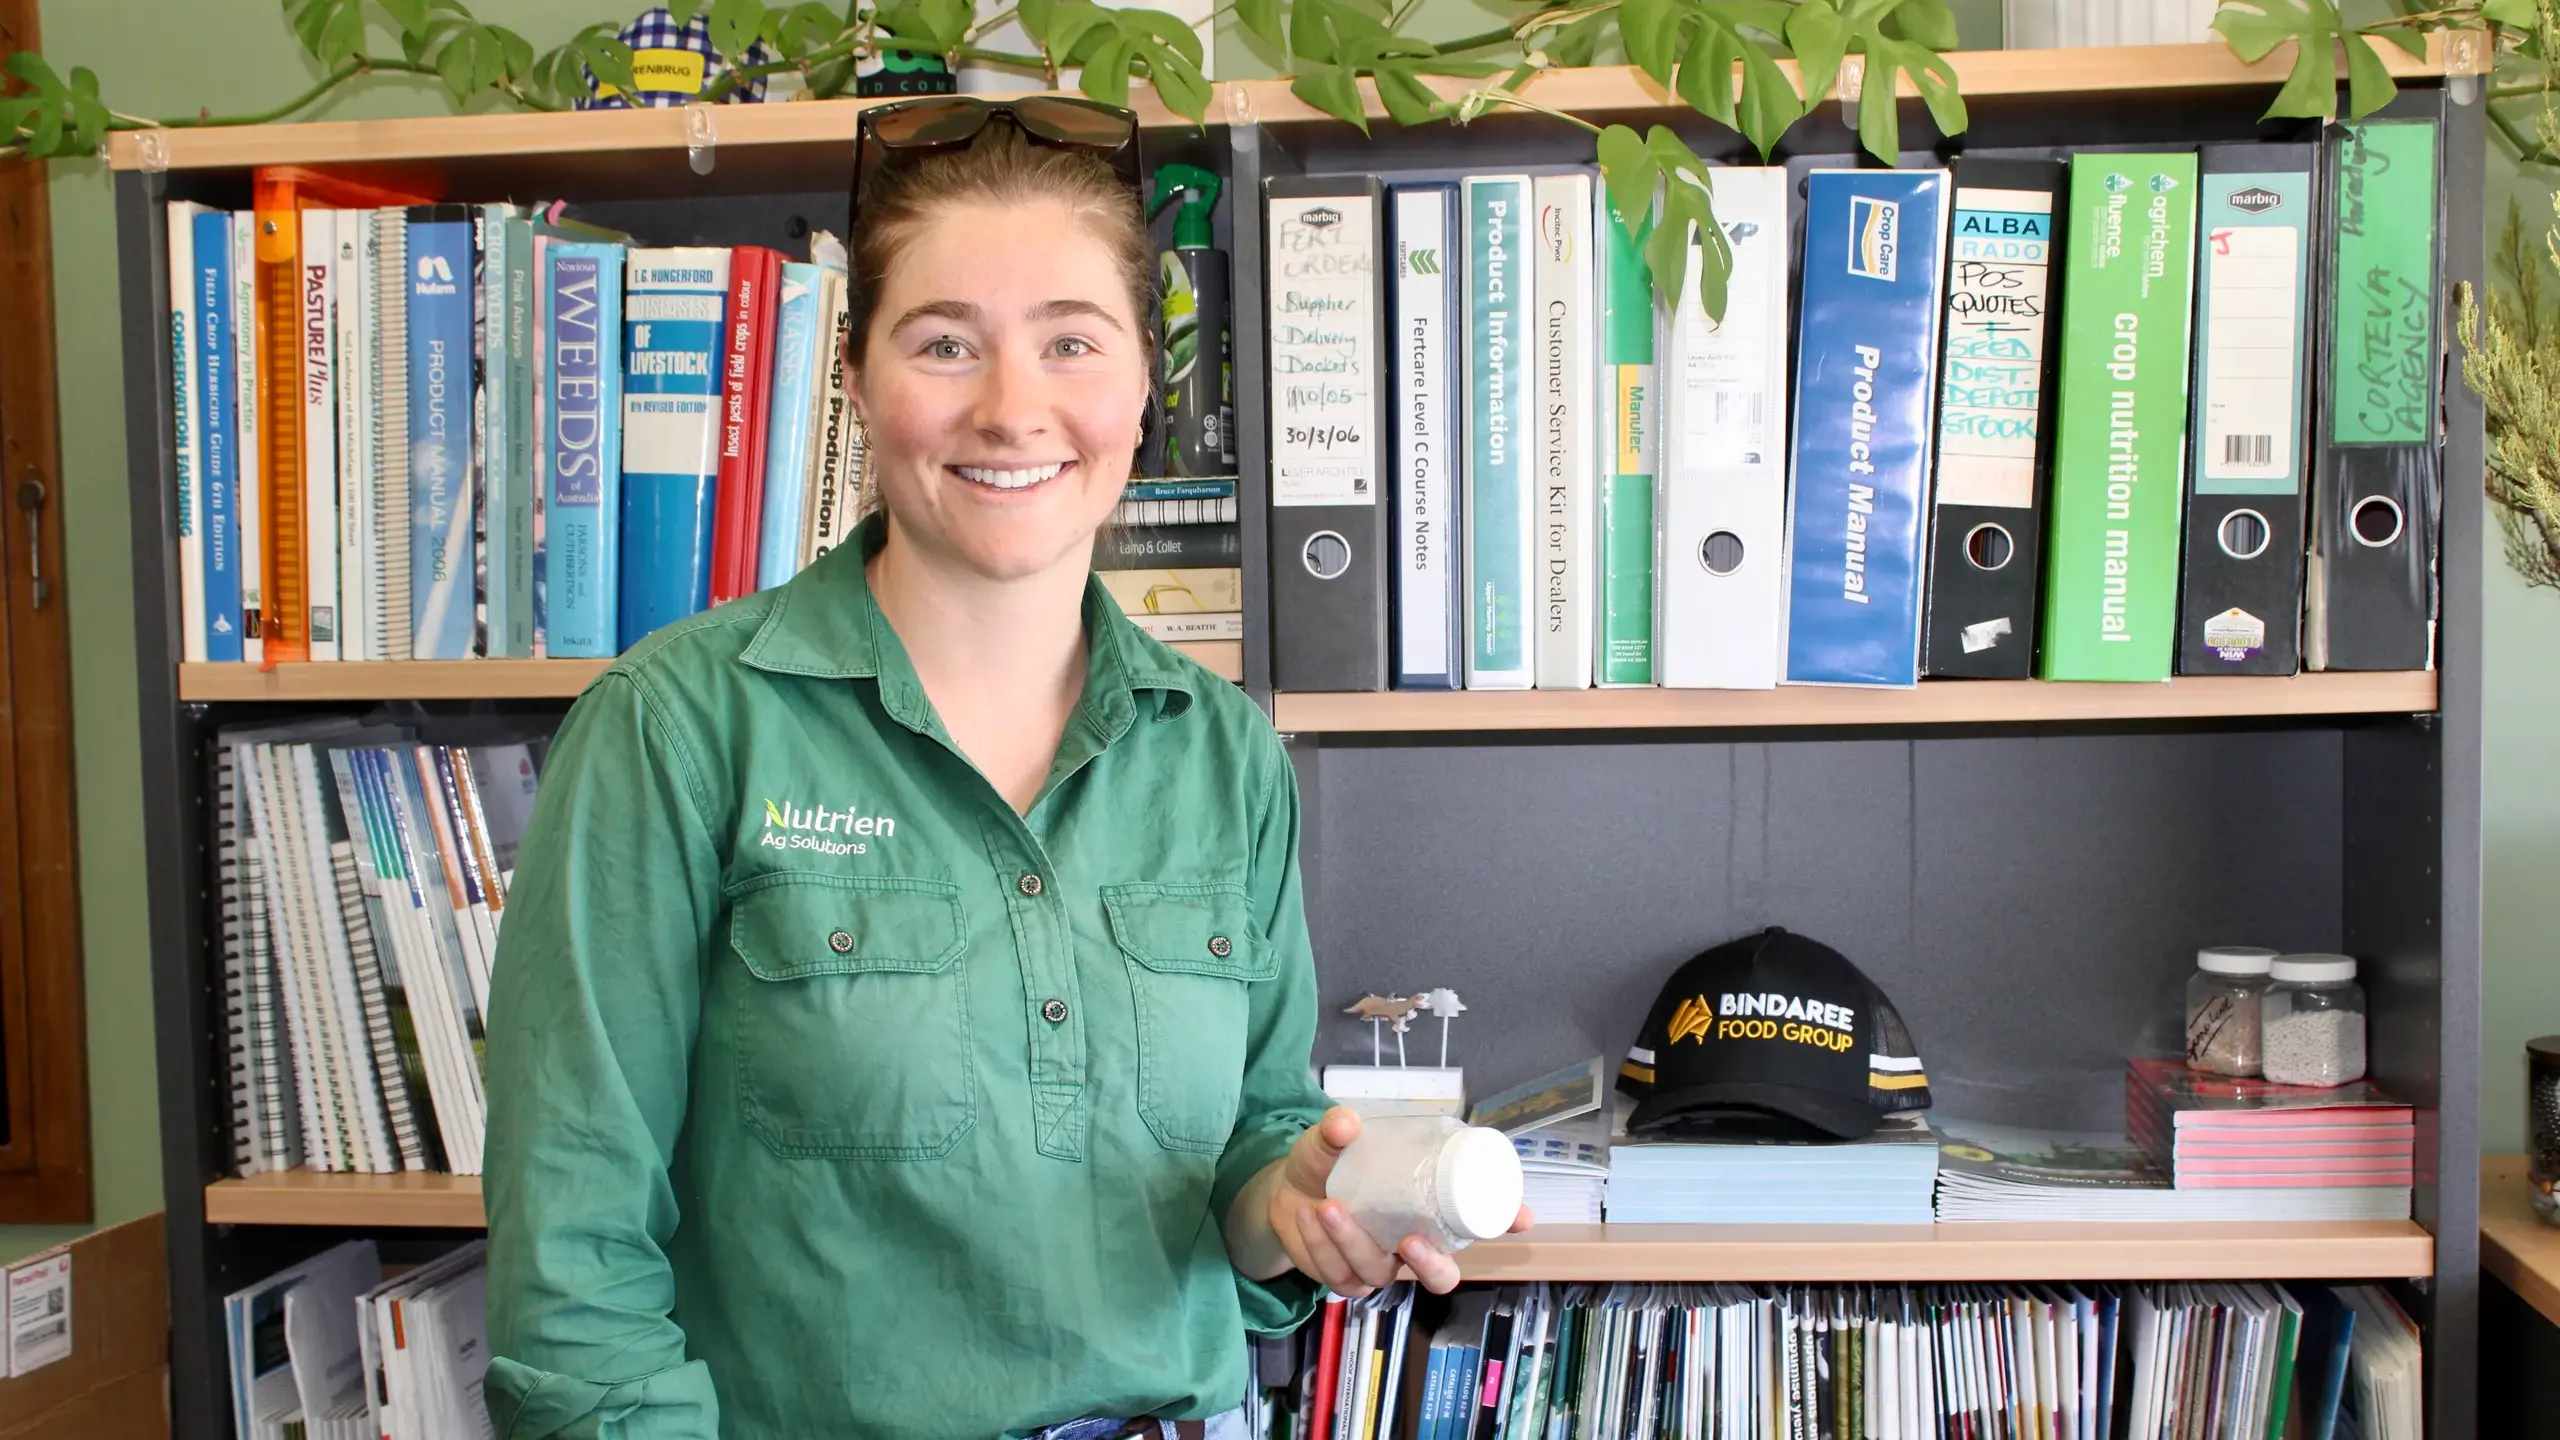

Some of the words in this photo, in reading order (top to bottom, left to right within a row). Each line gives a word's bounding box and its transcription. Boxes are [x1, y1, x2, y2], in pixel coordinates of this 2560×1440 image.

[2231, 191, 2279, 206] marbig
[1302, 211, 1340, 224] marbig
[1553, 207, 1561, 238] Incitec
[1878, 205, 1895, 241] Crop
[1962, 215, 2041, 236] ALBA
[2106, 194, 2128, 259] fluence
[487, 222, 503, 275] CROP
[1280, 219, 1344, 253] FERT
[1488, 200, 1507, 303] Product
[1554, 239, 1562, 262] Pivot
[1961, 240, 2043, 261] RADO
[2147, 195, 2171, 278] agrichem
[2209, 231, 2233, 256] J
[556, 261, 596, 272] Noxious
[1879, 243, 1894, 276] Care
[1957, 261, 2025, 289] POS
[416, 282, 456, 295] Nufarm
[513, 269, 524, 301] Plant
[651, 269, 713, 283] HUNGERFORD
[634, 295, 710, 319] DISEASES
[740, 280, 751, 308] colour
[1276, 291, 1356, 322] Supplier
[1949, 290, 2044, 319] QUOTES
[238, 280, 252, 356] Agronomy
[488, 284, 504, 349] WEEDS
[739, 308, 748, 319] in
[511, 304, 524, 359] Analysis
[635, 325, 651, 348] OF
[734, 322, 749, 352] crops
[1272, 325, 1357, 356] Delivery
[1948, 335, 2032, 359] SEED
[2106, 312, 2139, 382] crop
[631, 352, 709, 376] LIVESTOCK
[1273, 354, 1360, 375] Dockets
[1413, 318, 1428, 388] Fertcare
[1549, 300, 1567, 397] Customer
[2356, 263, 2397, 437] CORTEVA
[2393, 276, 2429, 434] AGENCY
[171, 310, 189, 448] CONSERVATION
[241, 360, 250, 373] in
[557, 274, 598, 477] WEEDS
[731, 354, 746, 378] field
[429, 340, 446, 440] PRODUCT
[733, 374, 744, 391] of
[1488, 311, 1509, 466] Information
[1946, 383, 2039, 408] DEPOT
[241, 376, 254, 433] Practice
[643, 402, 674, 413] REVISED
[676, 402, 707, 413] EDITION
[728, 394, 744, 422] pests
[1414, 394, 1429, 437] Level
[1629, 386, 1645, 454] Manutec
[1849, 344, 1881, 475] Product
[723, 419, 740, 458] Insect
[1285, 425, 1361, 450] 30/3/06
[1549, 404, 1567, 477] Service
[1943, 411, 2038, 440] STOCK
[1414, 441, 1428, 453] C
[2106, 390, 2140, 521] nutrition
[429, 445, 446, 531] MANUAL
[571, 480, 581, 491] of
[1316, 467, 1345, 477] ARCH
[1414, 457, 1429, 516] Course
[176, 454, 192, 537] FARMING
[556, 493, 600, 503] Australia
[1155, 486, 1175, 496] Bruce
[1177, 485, 1221, 496] Farquharson
[1549, 485, 1567, 516] Kit
[577, 524, 587, 577] PARSONS
[1119, 541, 1145, 556] Lamp
[1146, 540, 1154, 554] &
[1156, 540, 1182, 554] Collet
[1415, 521, 1430, 571] Notes
[1549, 523, 1567, 552] for
[1843, 483, 1875, 604] Manual
[431, 537, 446, 582] 2006
[565, 523, 575, 610] CUTHBERTSON
[1549, 559, 1567, 633] Dealers
[2101, 529, 2132, 643] manual
[1186, 623, 1217, 631] BEATTIE
[2219, 651, 2246, 659] WIN
[764, 797, 896, 837] Nutrien
[760, 831, 787, 850] Ag
[789, 834, 867, 855] Solutions
[1719, 992, 1855, 1033] BINDAREE
[1718, 1019, 1778, 1040] FOOD
[1782, 1022, 1853, 1053] GROUP
[1348, 1351, 1356, 1375] SHOOF
[1803, 1335, 1818, 1419] operations
[1427, 1370, 1438, 1402] CATALOG
[1447, 1369, 1457, 1401] CATALOG
[1462, 1369, 1473, 1401] CATALOG
[1342, 1376, 1353, 1433] INTERNATIONAL
